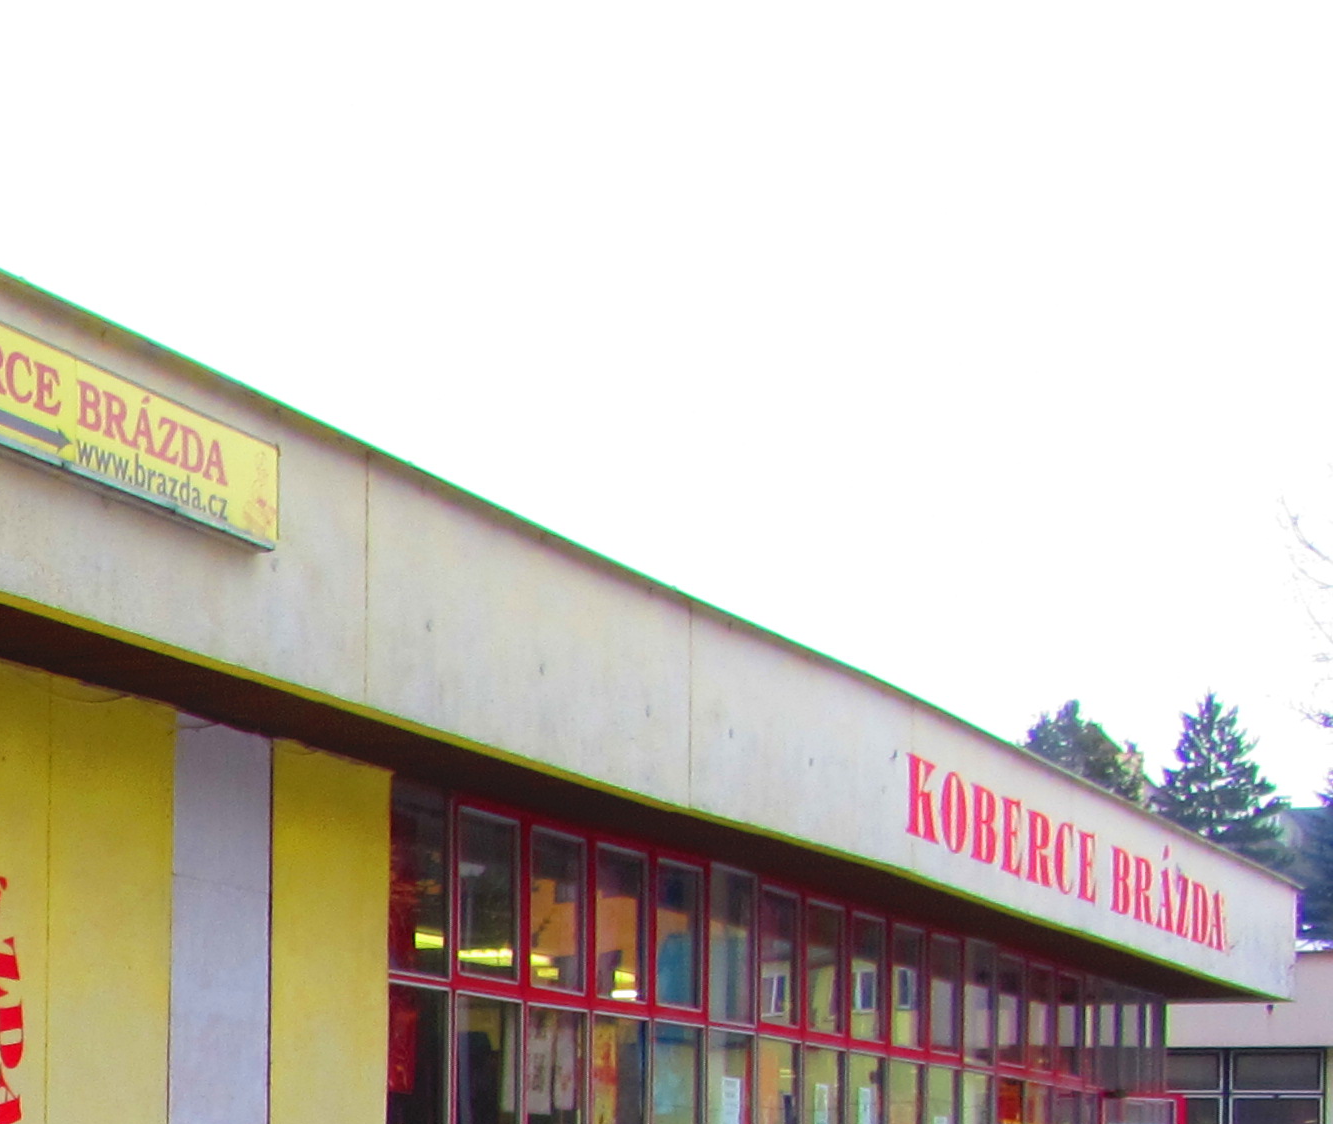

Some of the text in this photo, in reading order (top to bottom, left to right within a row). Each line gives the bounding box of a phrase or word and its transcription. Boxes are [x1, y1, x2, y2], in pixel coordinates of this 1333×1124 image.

[75, 438, 230, 522] www.brazda.cz
[76, 377, 230, 487] BRÁZDA
[905, 752, 1227, 953] KOBERCE BRÁZDA
